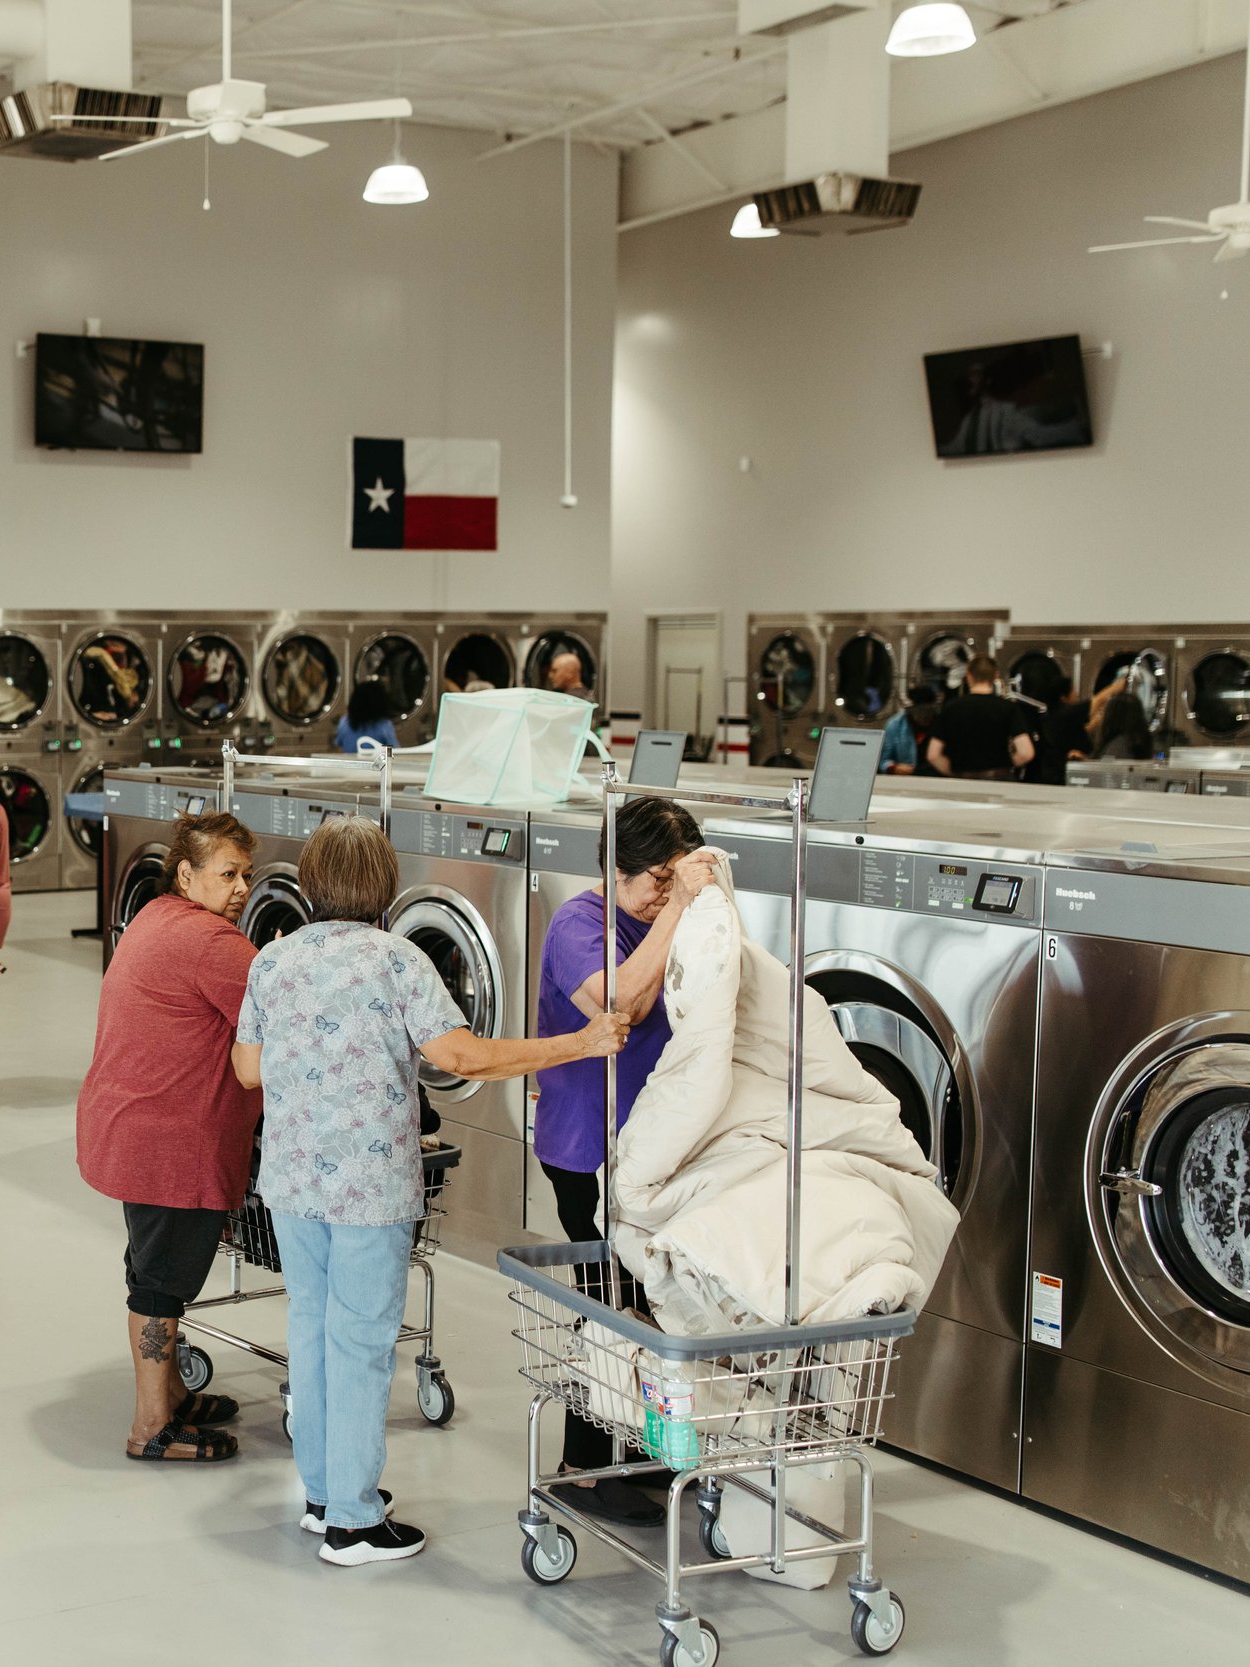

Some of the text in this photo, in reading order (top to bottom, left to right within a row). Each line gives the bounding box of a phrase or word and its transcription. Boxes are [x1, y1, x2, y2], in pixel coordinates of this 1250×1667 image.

[532, 874, 537, 891] 4
[1055, 887, 1096, 900] Huebsch
[1048, 938, 1056, 958] 6
